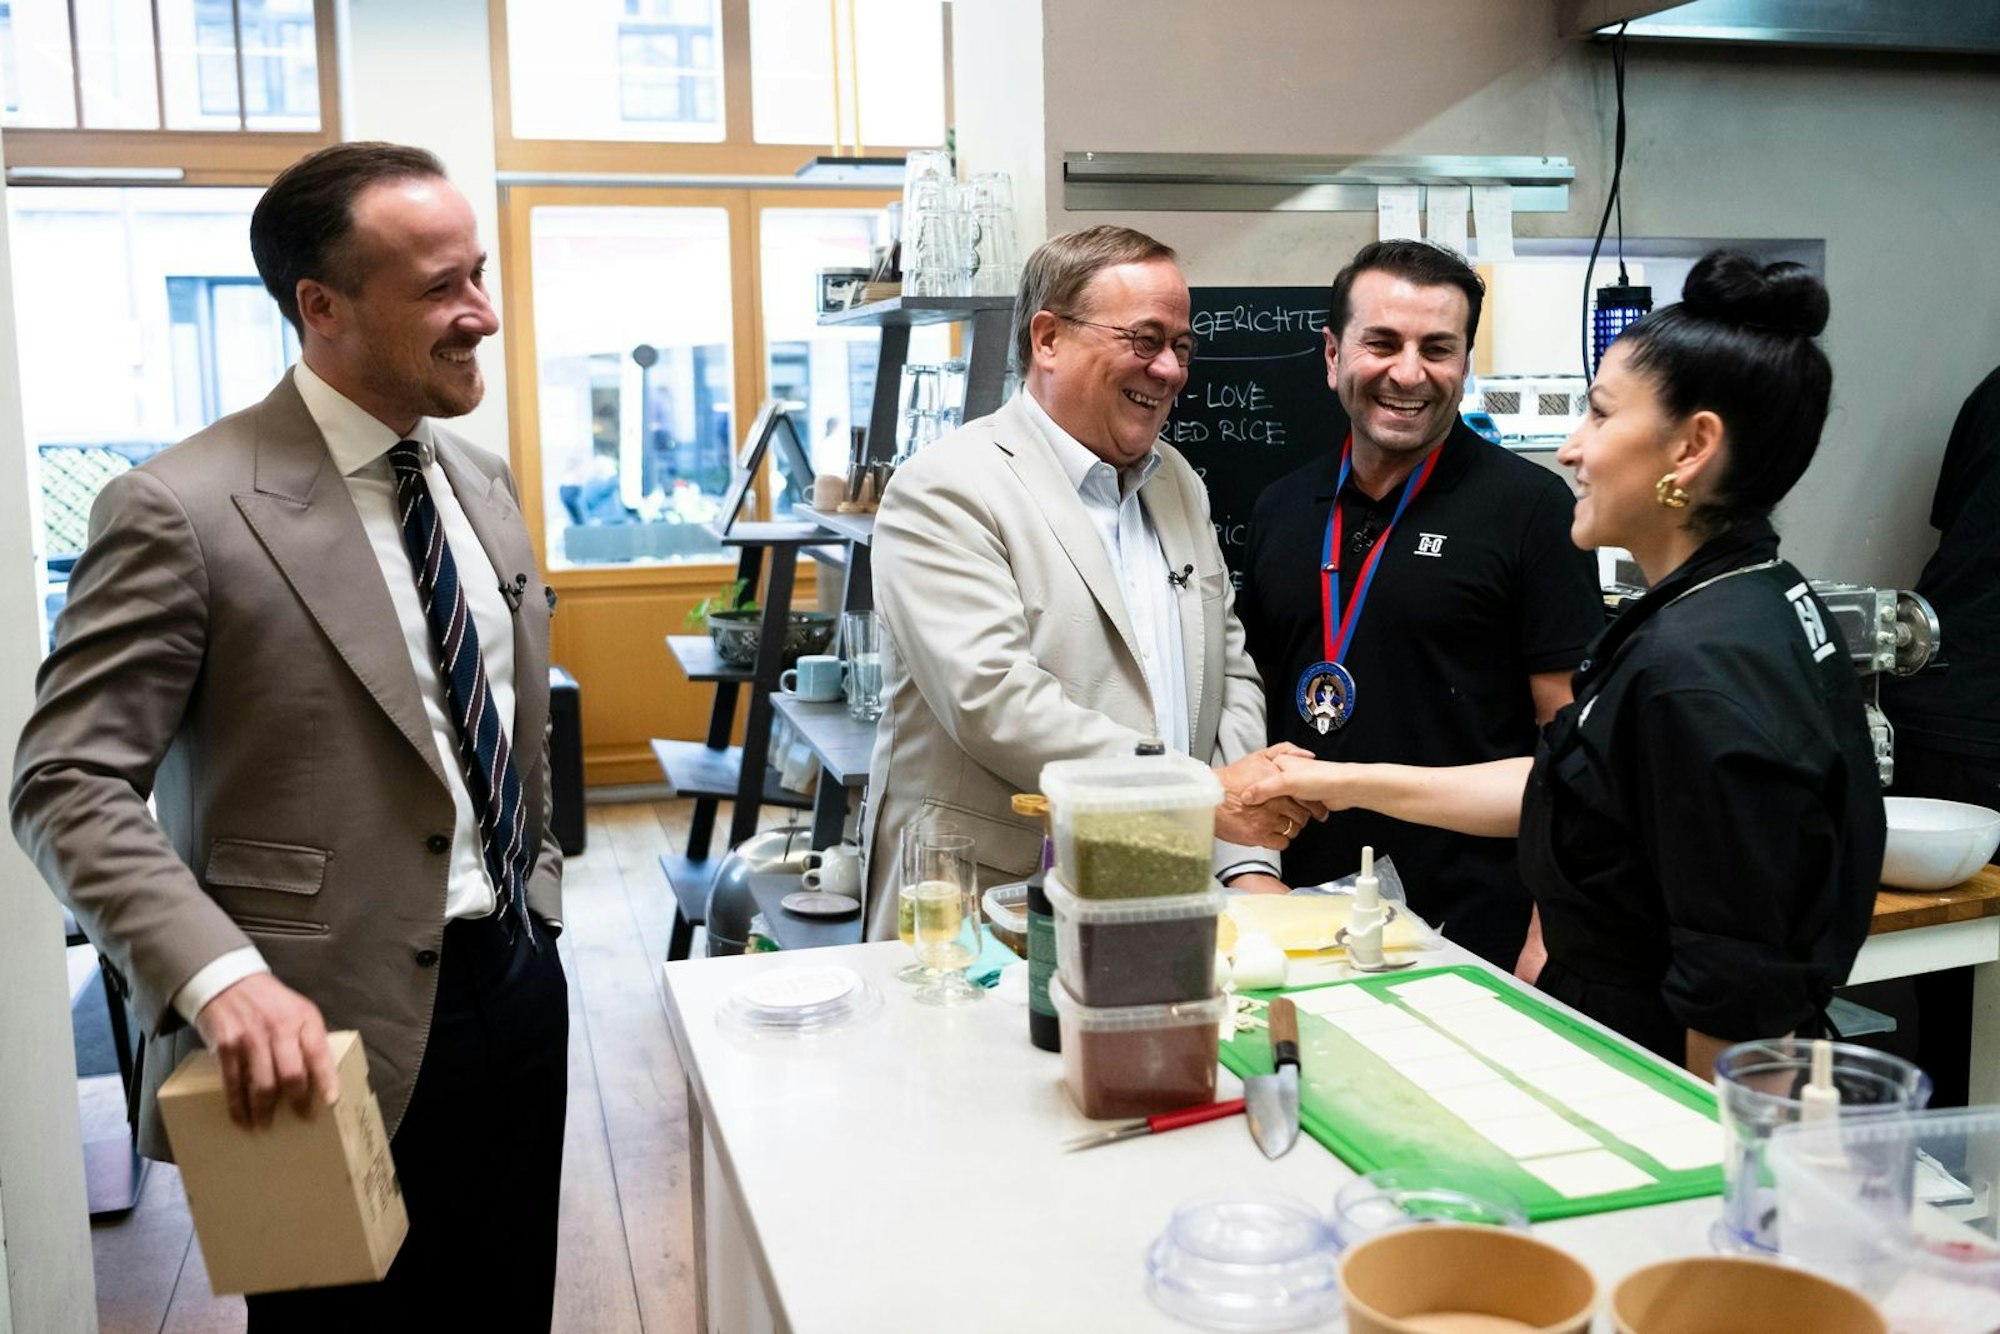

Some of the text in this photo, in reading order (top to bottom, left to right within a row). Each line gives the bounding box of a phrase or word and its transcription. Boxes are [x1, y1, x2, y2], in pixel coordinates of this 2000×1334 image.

[1206, 380, 1274, 410] LOVE
[1158, 417, 1287, 445] RIED RICE
